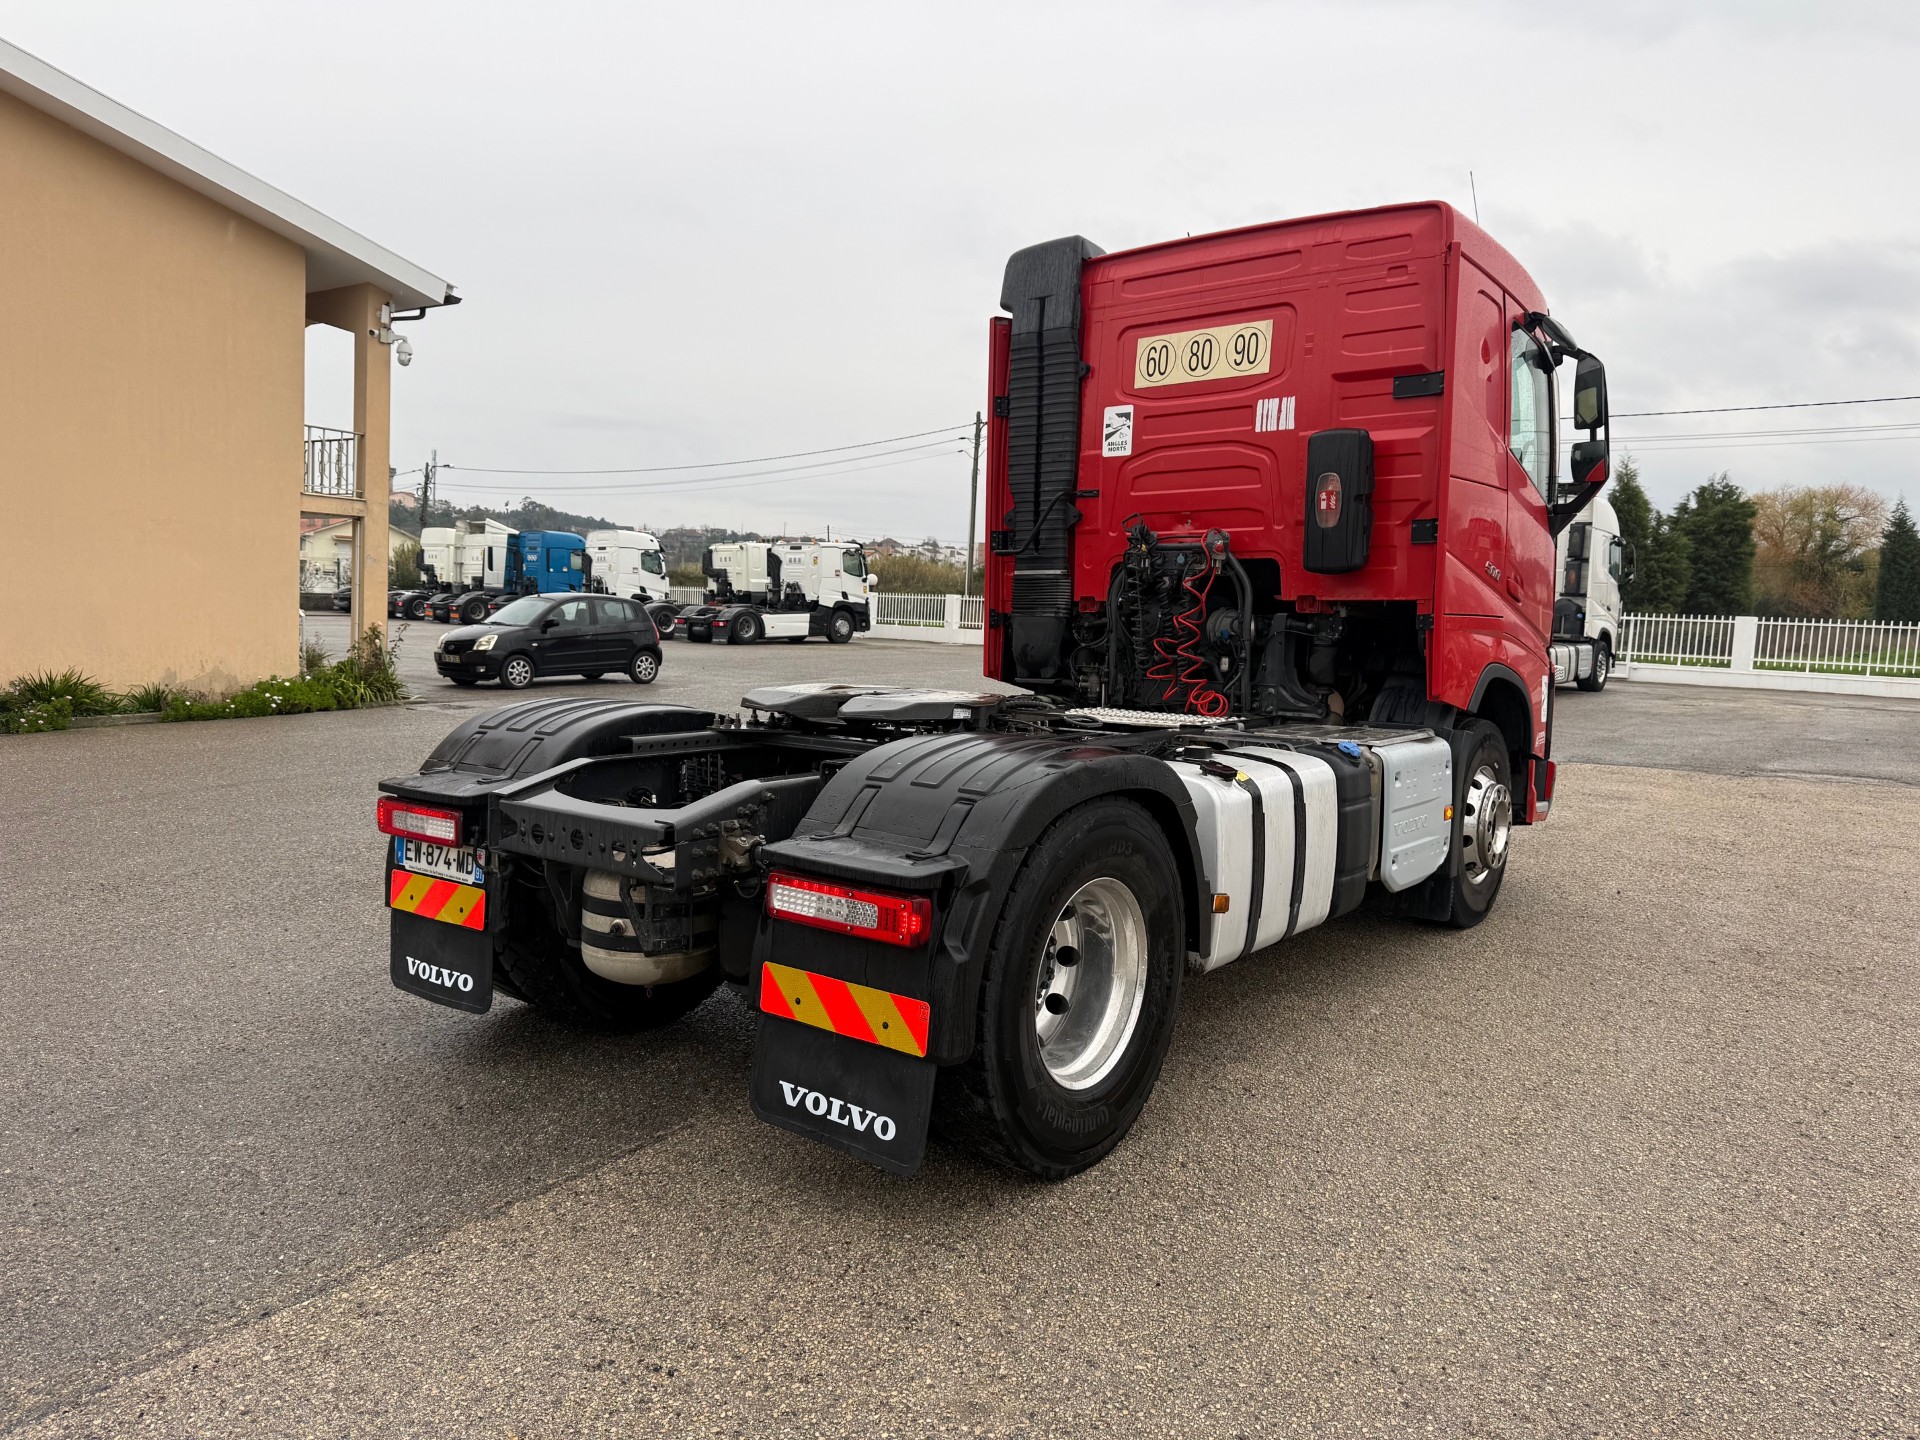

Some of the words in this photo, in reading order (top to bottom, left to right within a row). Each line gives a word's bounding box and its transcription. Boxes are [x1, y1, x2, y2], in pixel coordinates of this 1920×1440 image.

[1146, 344, 1169, 377] 60
[1188, 338, 1213, 372] 80
[1233, 332, 1259, 366] 90
[1393, 814, 1428, 837] VOLVO
[475, 868, 483, 879] 91
[405, 955, 474, 992] VOLVO
[778, 1079, 897, 1142] VOLVO
